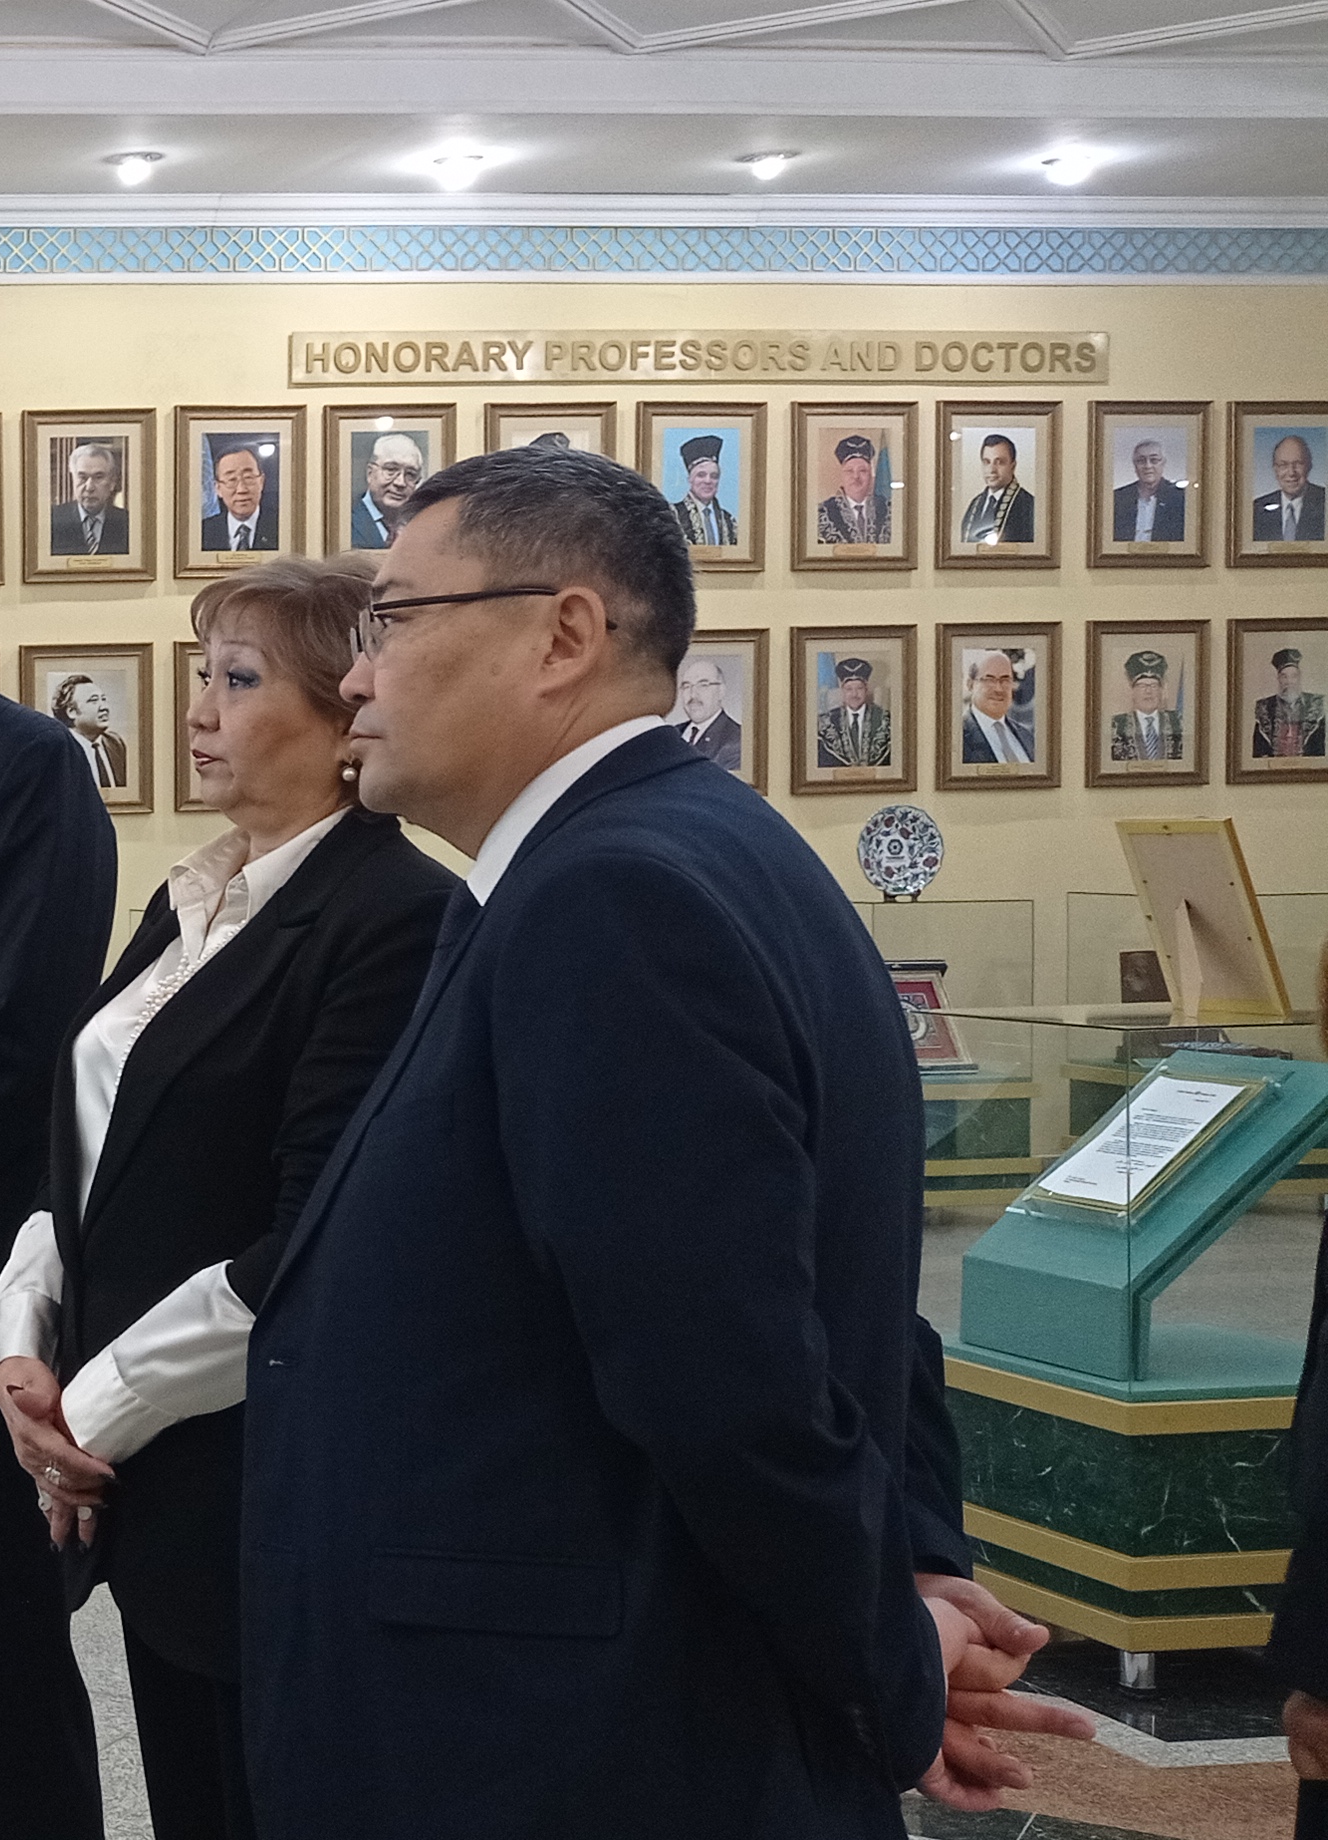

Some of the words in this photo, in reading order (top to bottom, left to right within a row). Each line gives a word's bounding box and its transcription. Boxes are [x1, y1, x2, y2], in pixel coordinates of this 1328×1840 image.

[304, 340, 534, 374] HONORARY
[544, 340, 811, 373] PROFESSORS
[820, 340, 903, 373] AND
[914, 341, 1097, 374] DOCTORS
